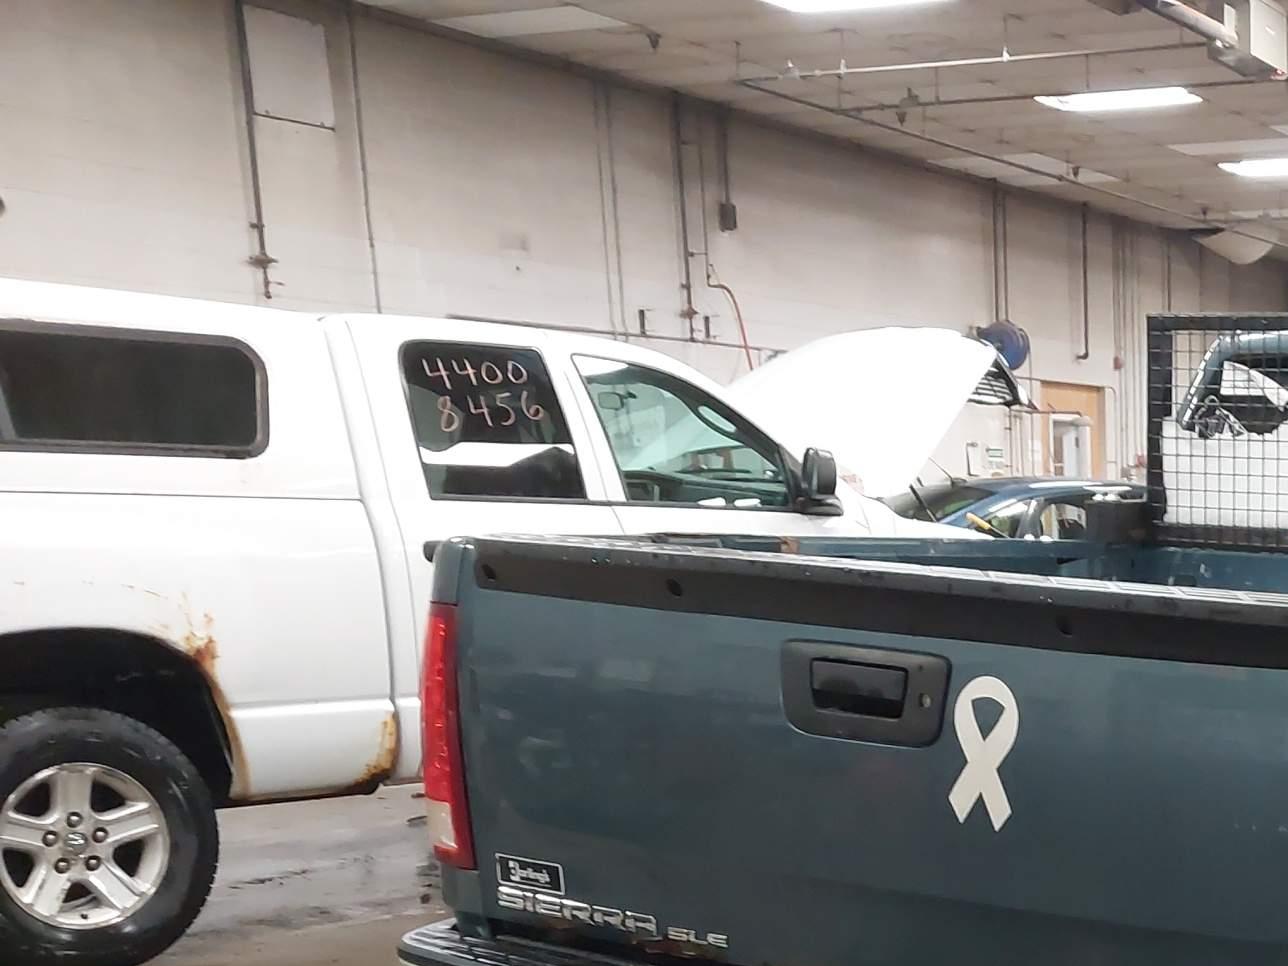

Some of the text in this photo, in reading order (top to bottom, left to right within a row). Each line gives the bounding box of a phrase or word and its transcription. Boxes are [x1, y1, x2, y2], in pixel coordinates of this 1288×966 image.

[421, 357, 528, 390] 4400
[437, 391, 544, 432] 8456
[497, 886, 729, 948] SIERRA SLE
